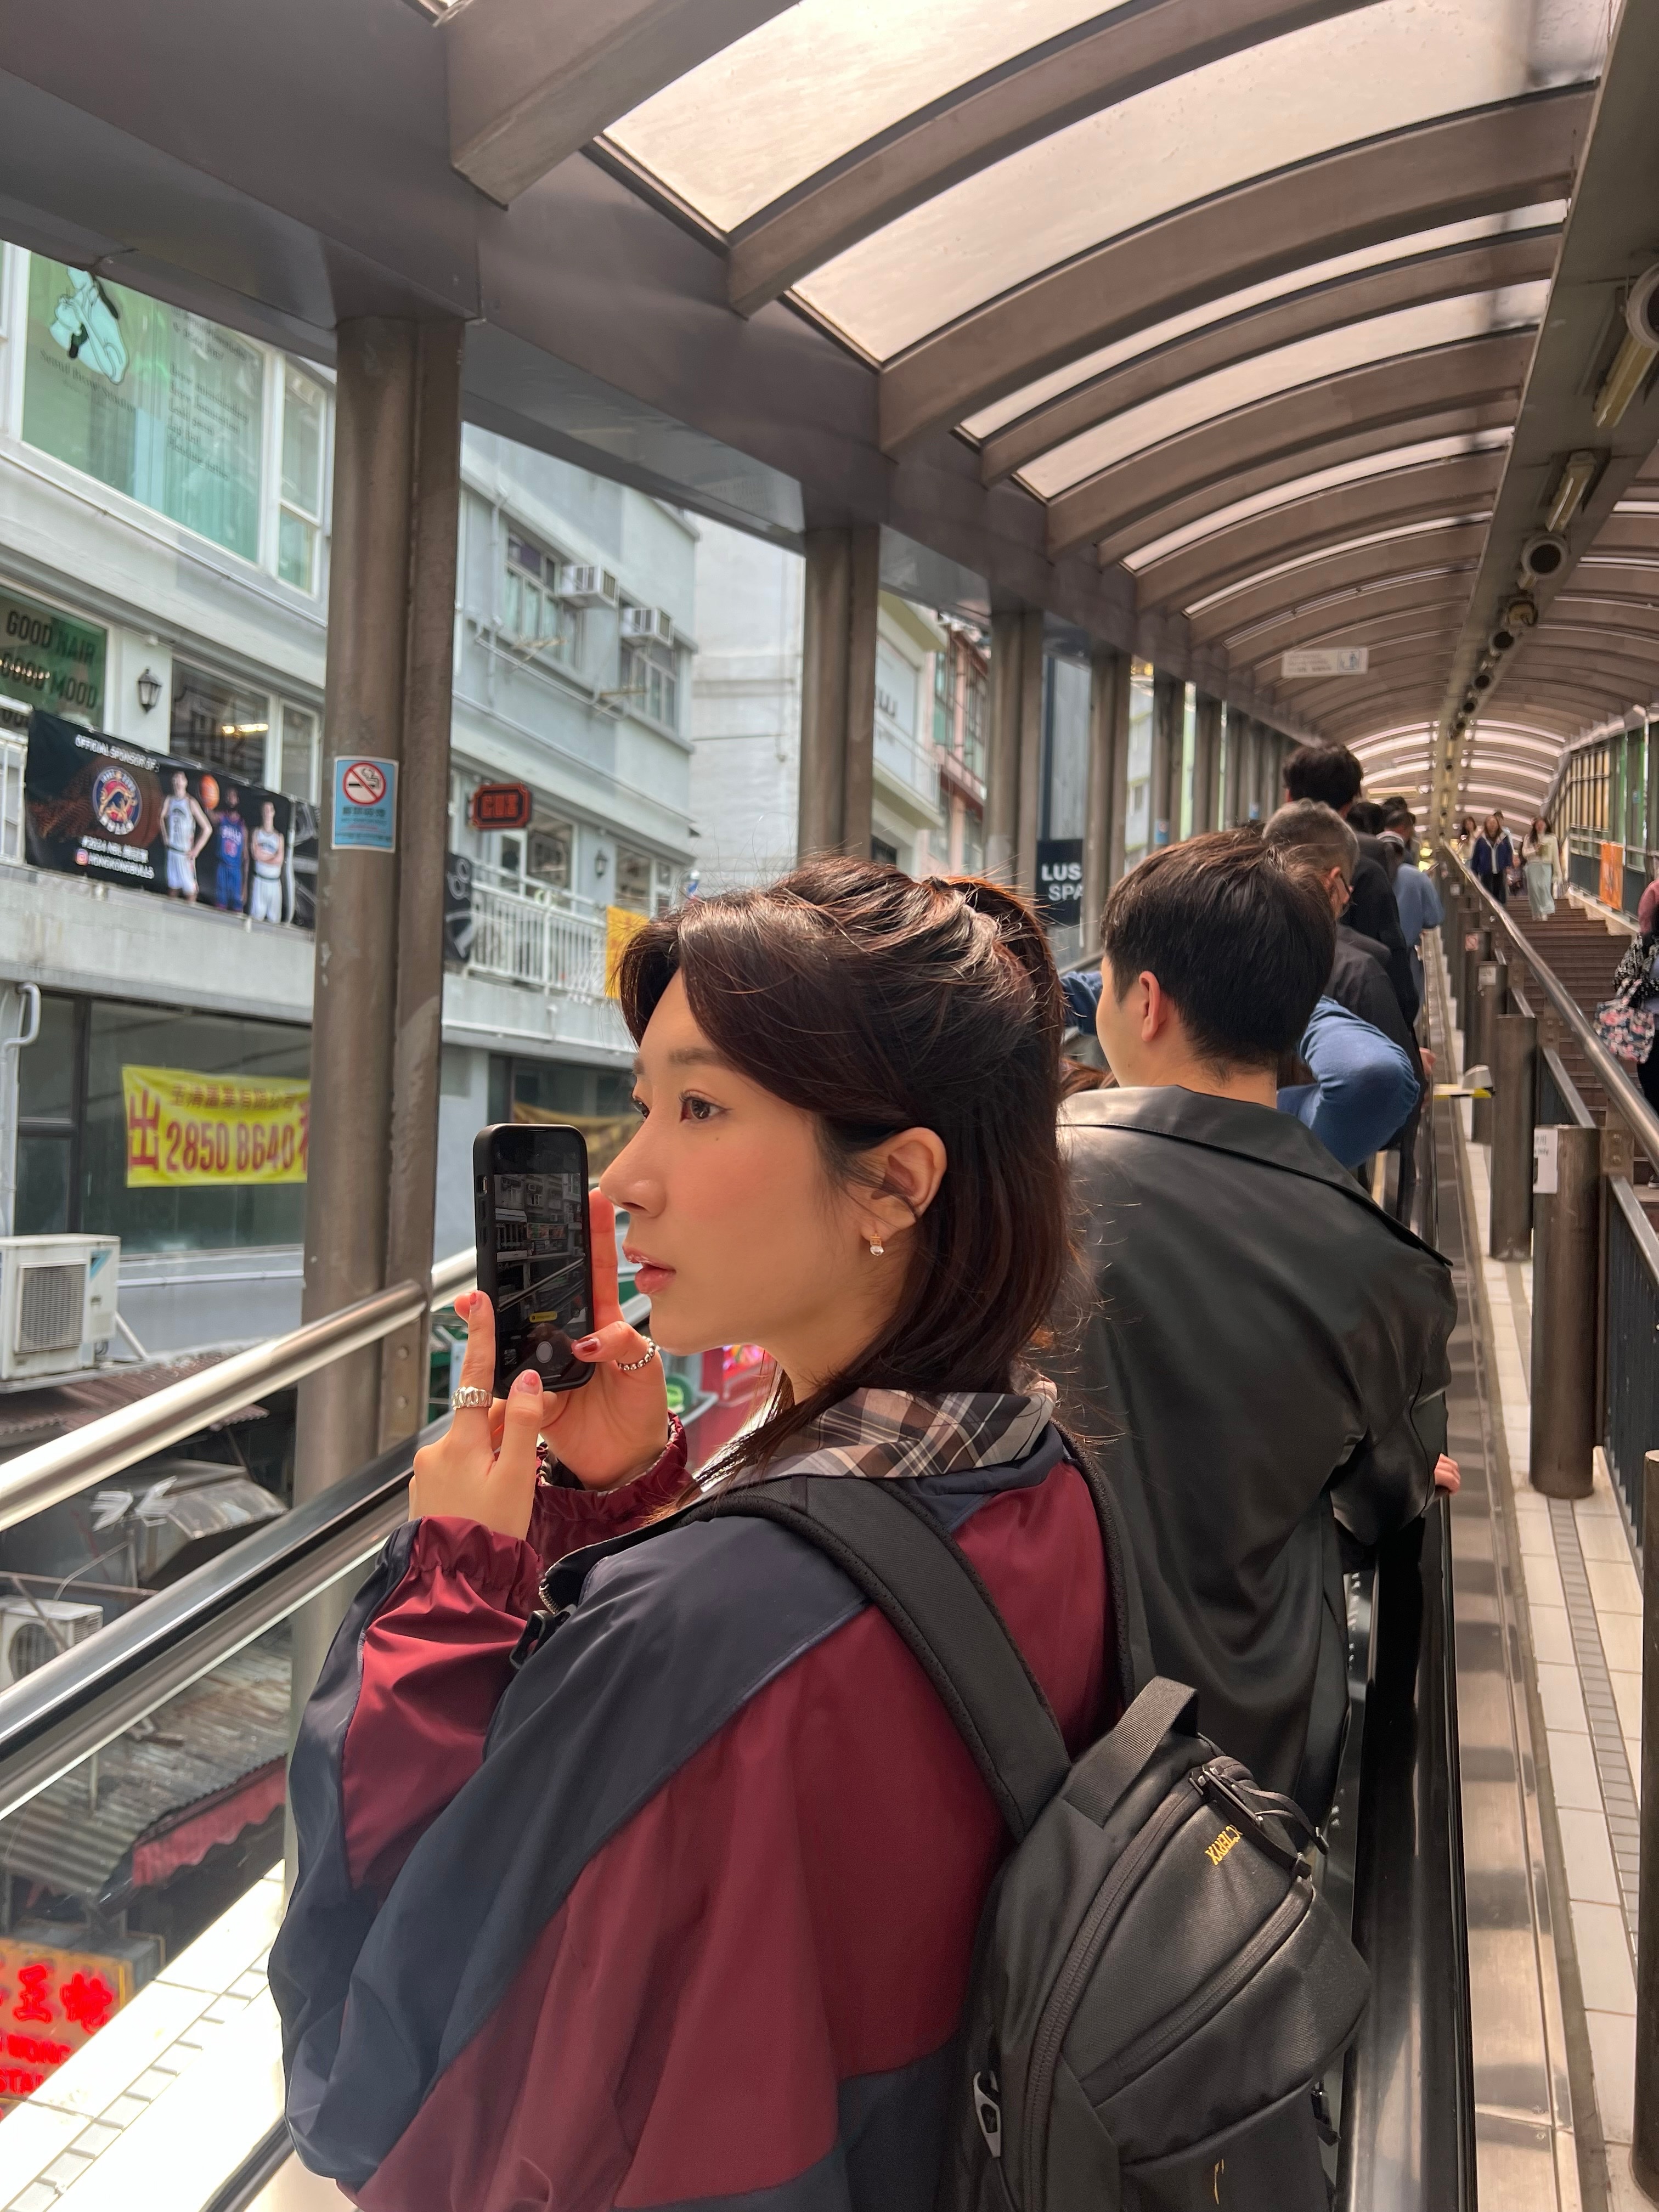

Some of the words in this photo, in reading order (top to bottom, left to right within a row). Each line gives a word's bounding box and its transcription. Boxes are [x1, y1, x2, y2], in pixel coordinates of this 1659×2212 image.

[7, 610, 53, 648] GOOD
[56, 629, 96, 666] HAIR
[51, 669, 97, 709] MOOD
[1048, 883, 1083, 901] SPA
[128, 1087, 161, 1172] 出
[166, 1120, 230, 1173] 2850
